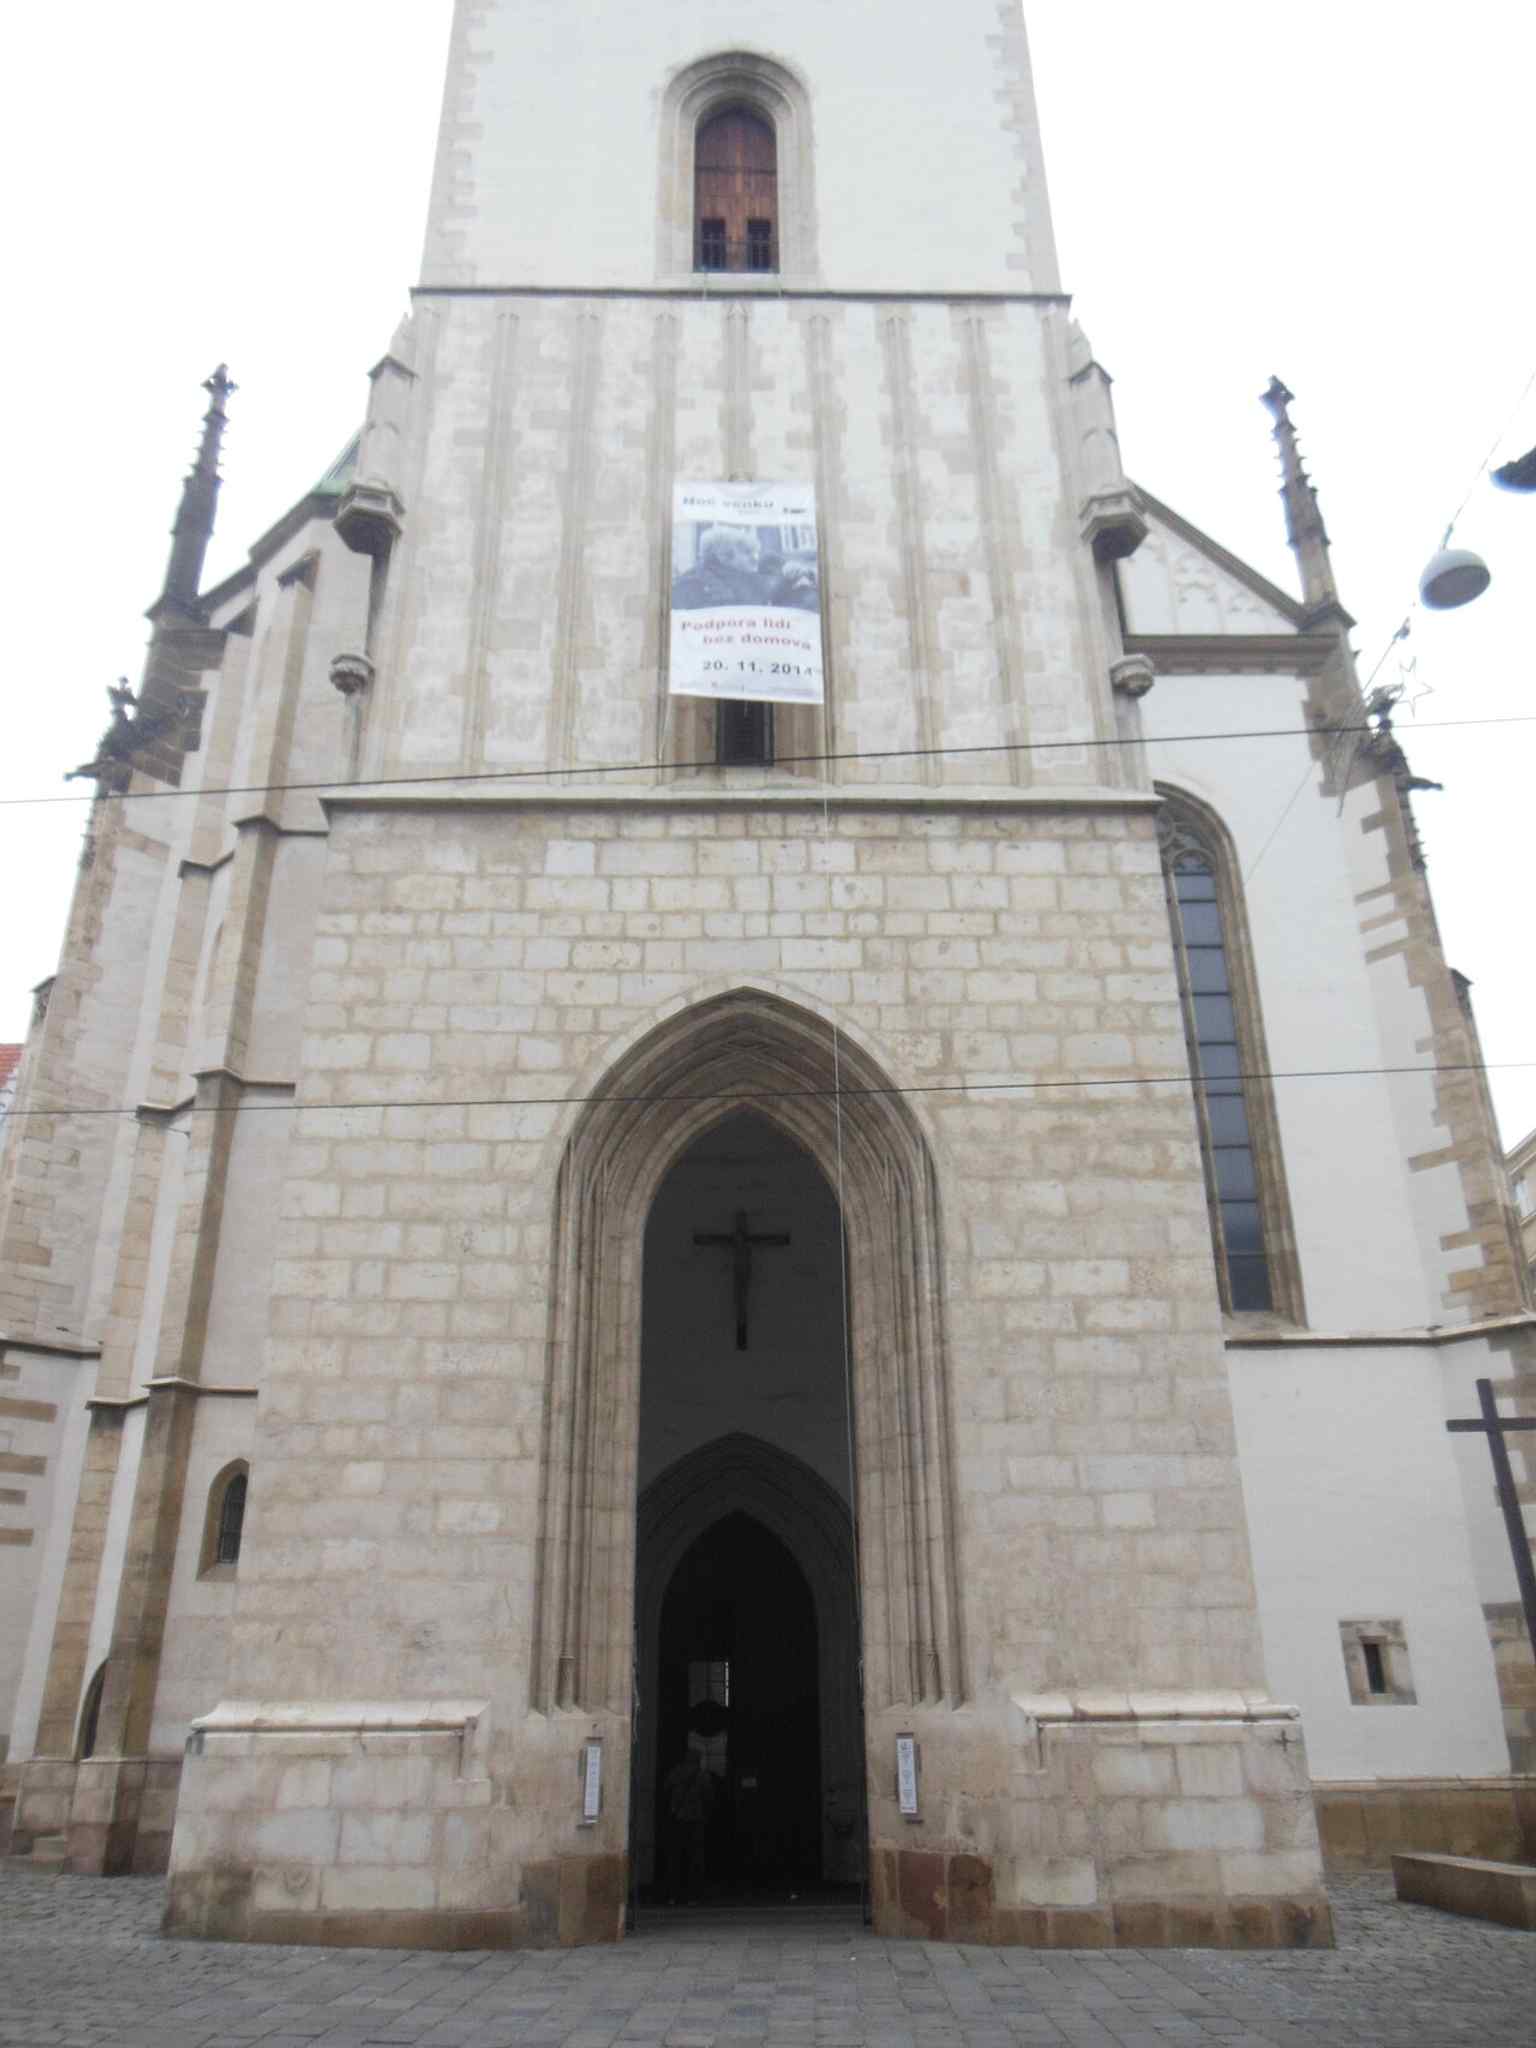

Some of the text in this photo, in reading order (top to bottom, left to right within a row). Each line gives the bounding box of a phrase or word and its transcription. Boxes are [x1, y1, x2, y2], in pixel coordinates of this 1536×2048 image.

[680, 617, 757, 631] Podpora
[741, 633, 812, 651] domova
[703, 660, 728, 671] 20.
[737, 660, 763, 673] 11.
